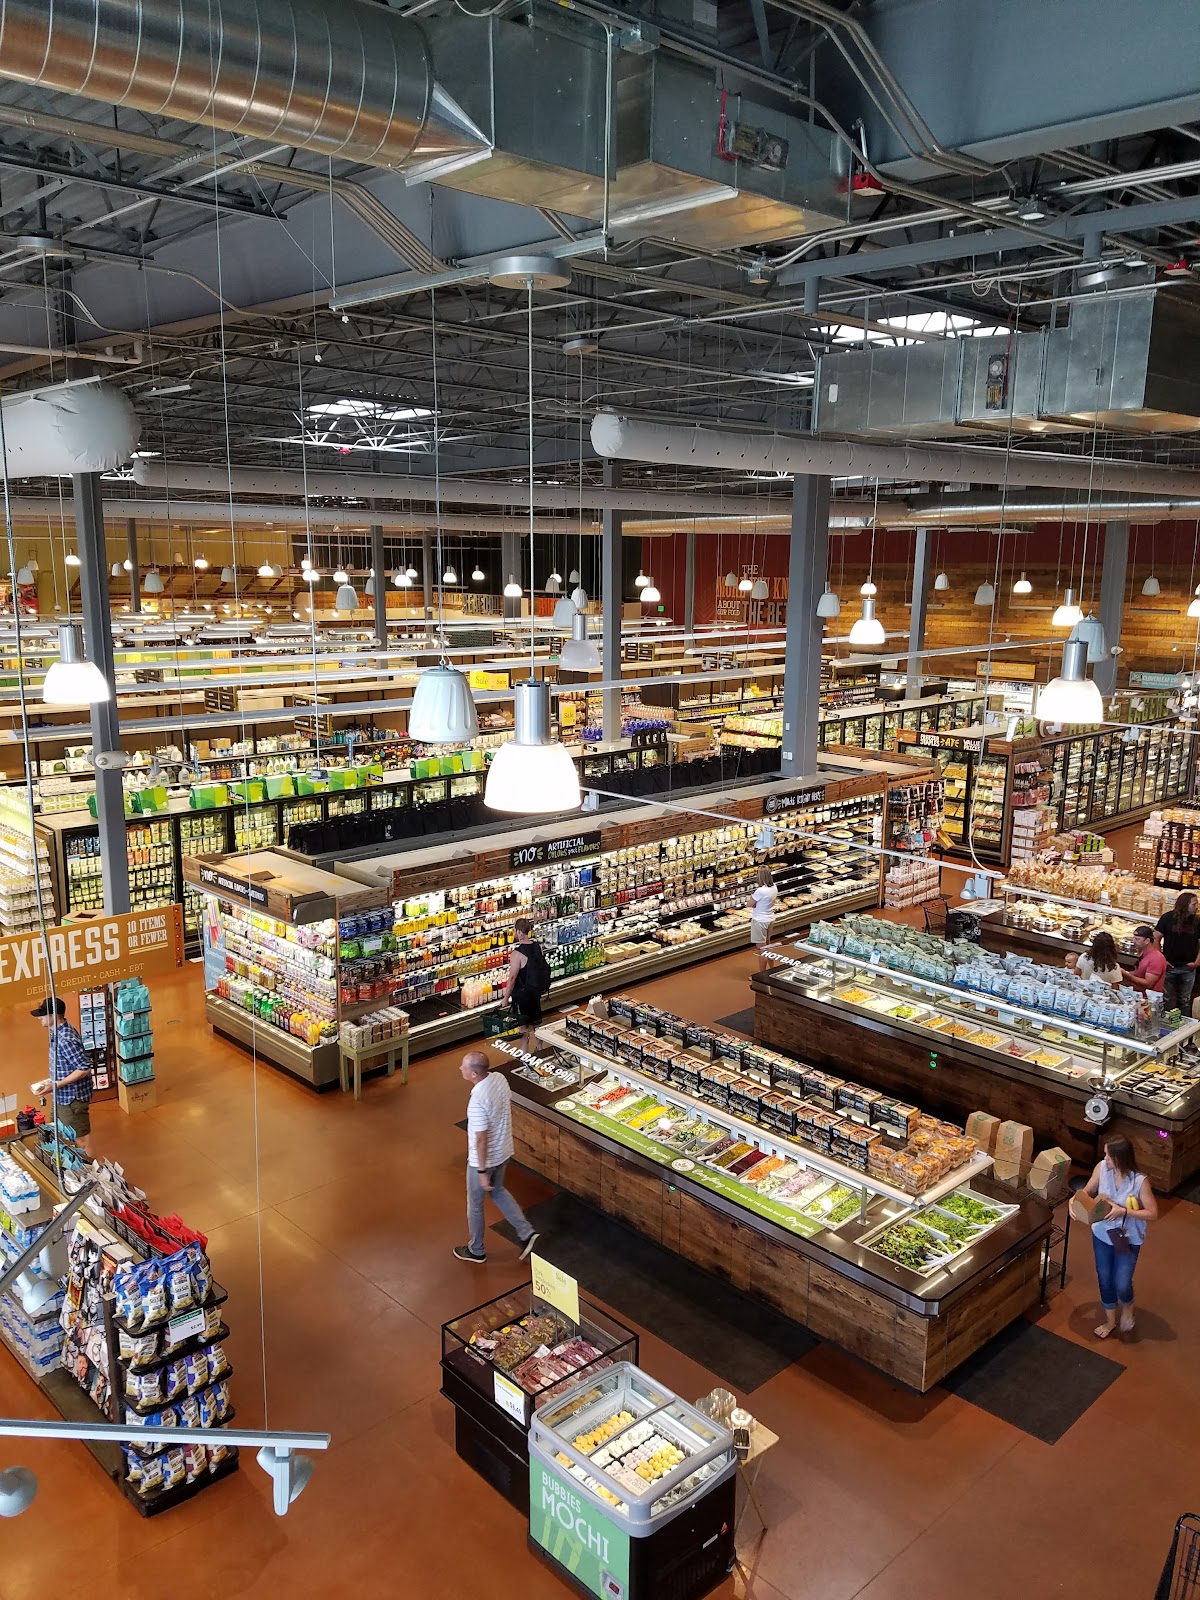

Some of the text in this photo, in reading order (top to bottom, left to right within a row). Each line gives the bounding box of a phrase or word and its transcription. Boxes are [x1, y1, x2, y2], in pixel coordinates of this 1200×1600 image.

[742, 565, 758, 574] THE
[718, 601, 740, 609] ABOUT
[742, 601, 764, 624] THE
[475, 675, 488, 684] Sale
[945, 738, 955, 747] AT
[547, 837, 584, 851] ARTIFICIAL
[548, 849, 567, 859] COLORS
[578, 842, 600, 853] FLAVORS
[127, 915, 166, 934] 10 ITEMS
[128, 929, 168, 948] OR FEWER
[761, 950, 783, 961] HOT
[780, 956, 801, 967] BAR
[61, 974, 91, 988] CREDIT
[99, 968, 120, 979] CASH
[128, 962, 145, 973] EBT
[491, 1040, 523, 1057] SALAD
[520, 1053, 543, 1067] BAR
[785, 1216, 814, 1232] Organic
[542, 1471, 581, 1513] BUBBIES
[542, 1485, 609, 1564] MOCHI
